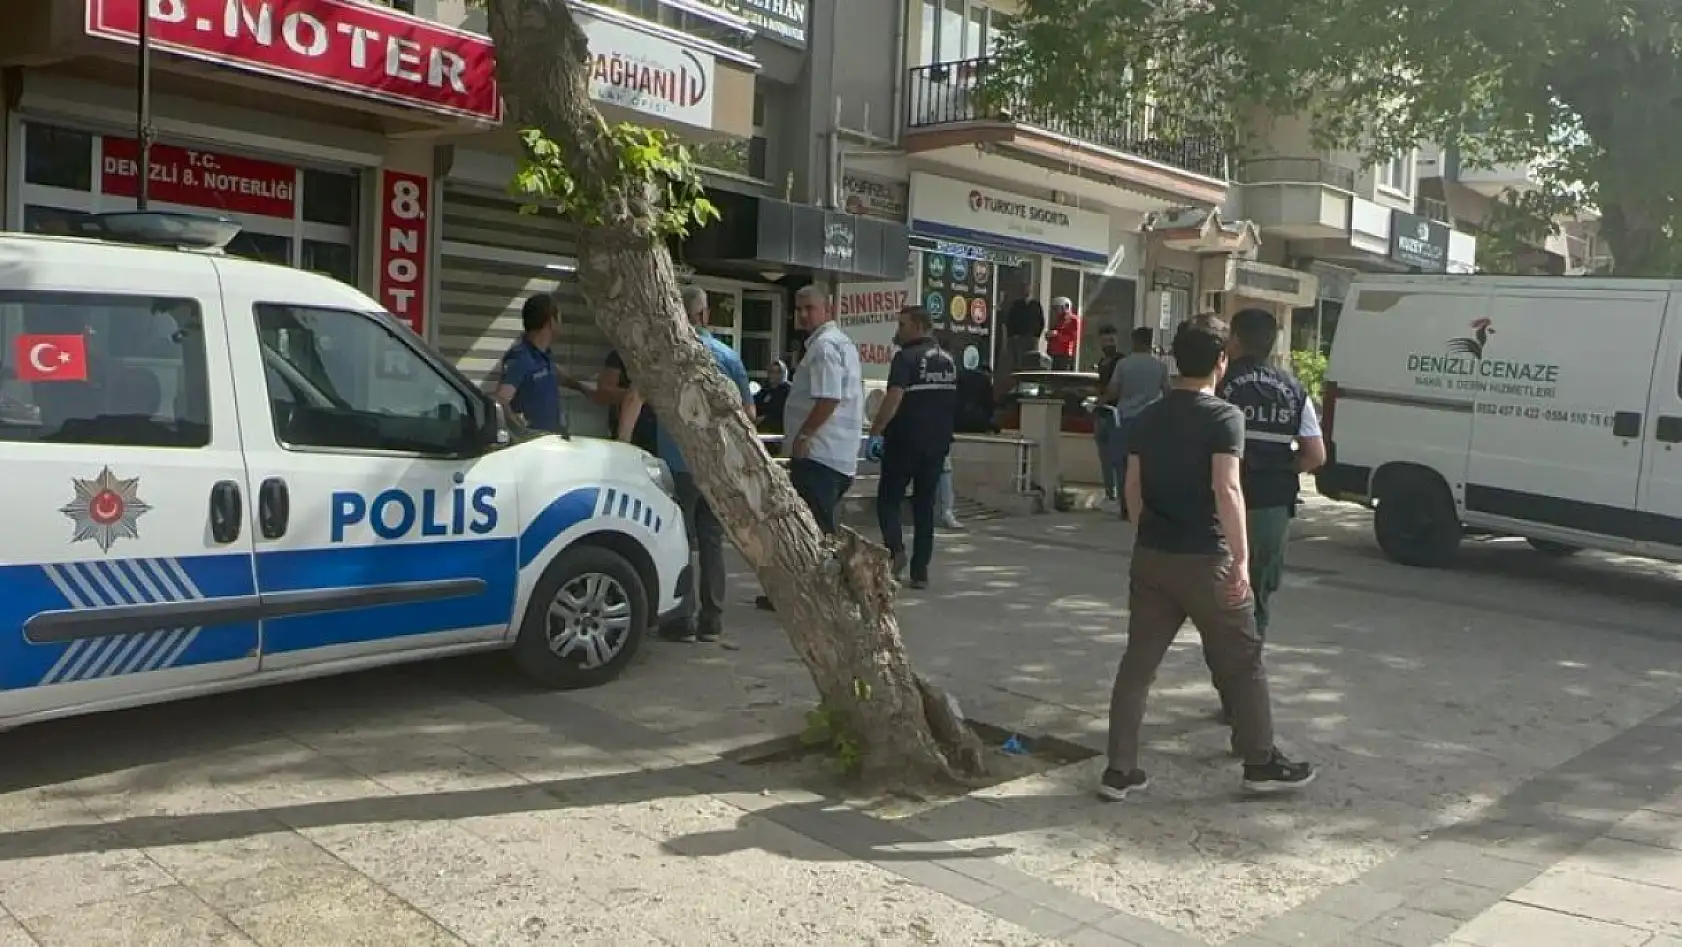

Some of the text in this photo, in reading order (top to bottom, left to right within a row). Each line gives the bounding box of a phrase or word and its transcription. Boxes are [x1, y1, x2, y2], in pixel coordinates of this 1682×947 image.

[187, 151, 221, 169] T.C.
[104, 156, 293, 200] DENZLİ 8. NOTERLİĞİ
[387, 179, 425, 330] 8. NOT
[1479, 359, 1561, 383] CENAZE
[1243, 402, 1292, 424] OLİS
[331, 471, 498, 542] POLİS
